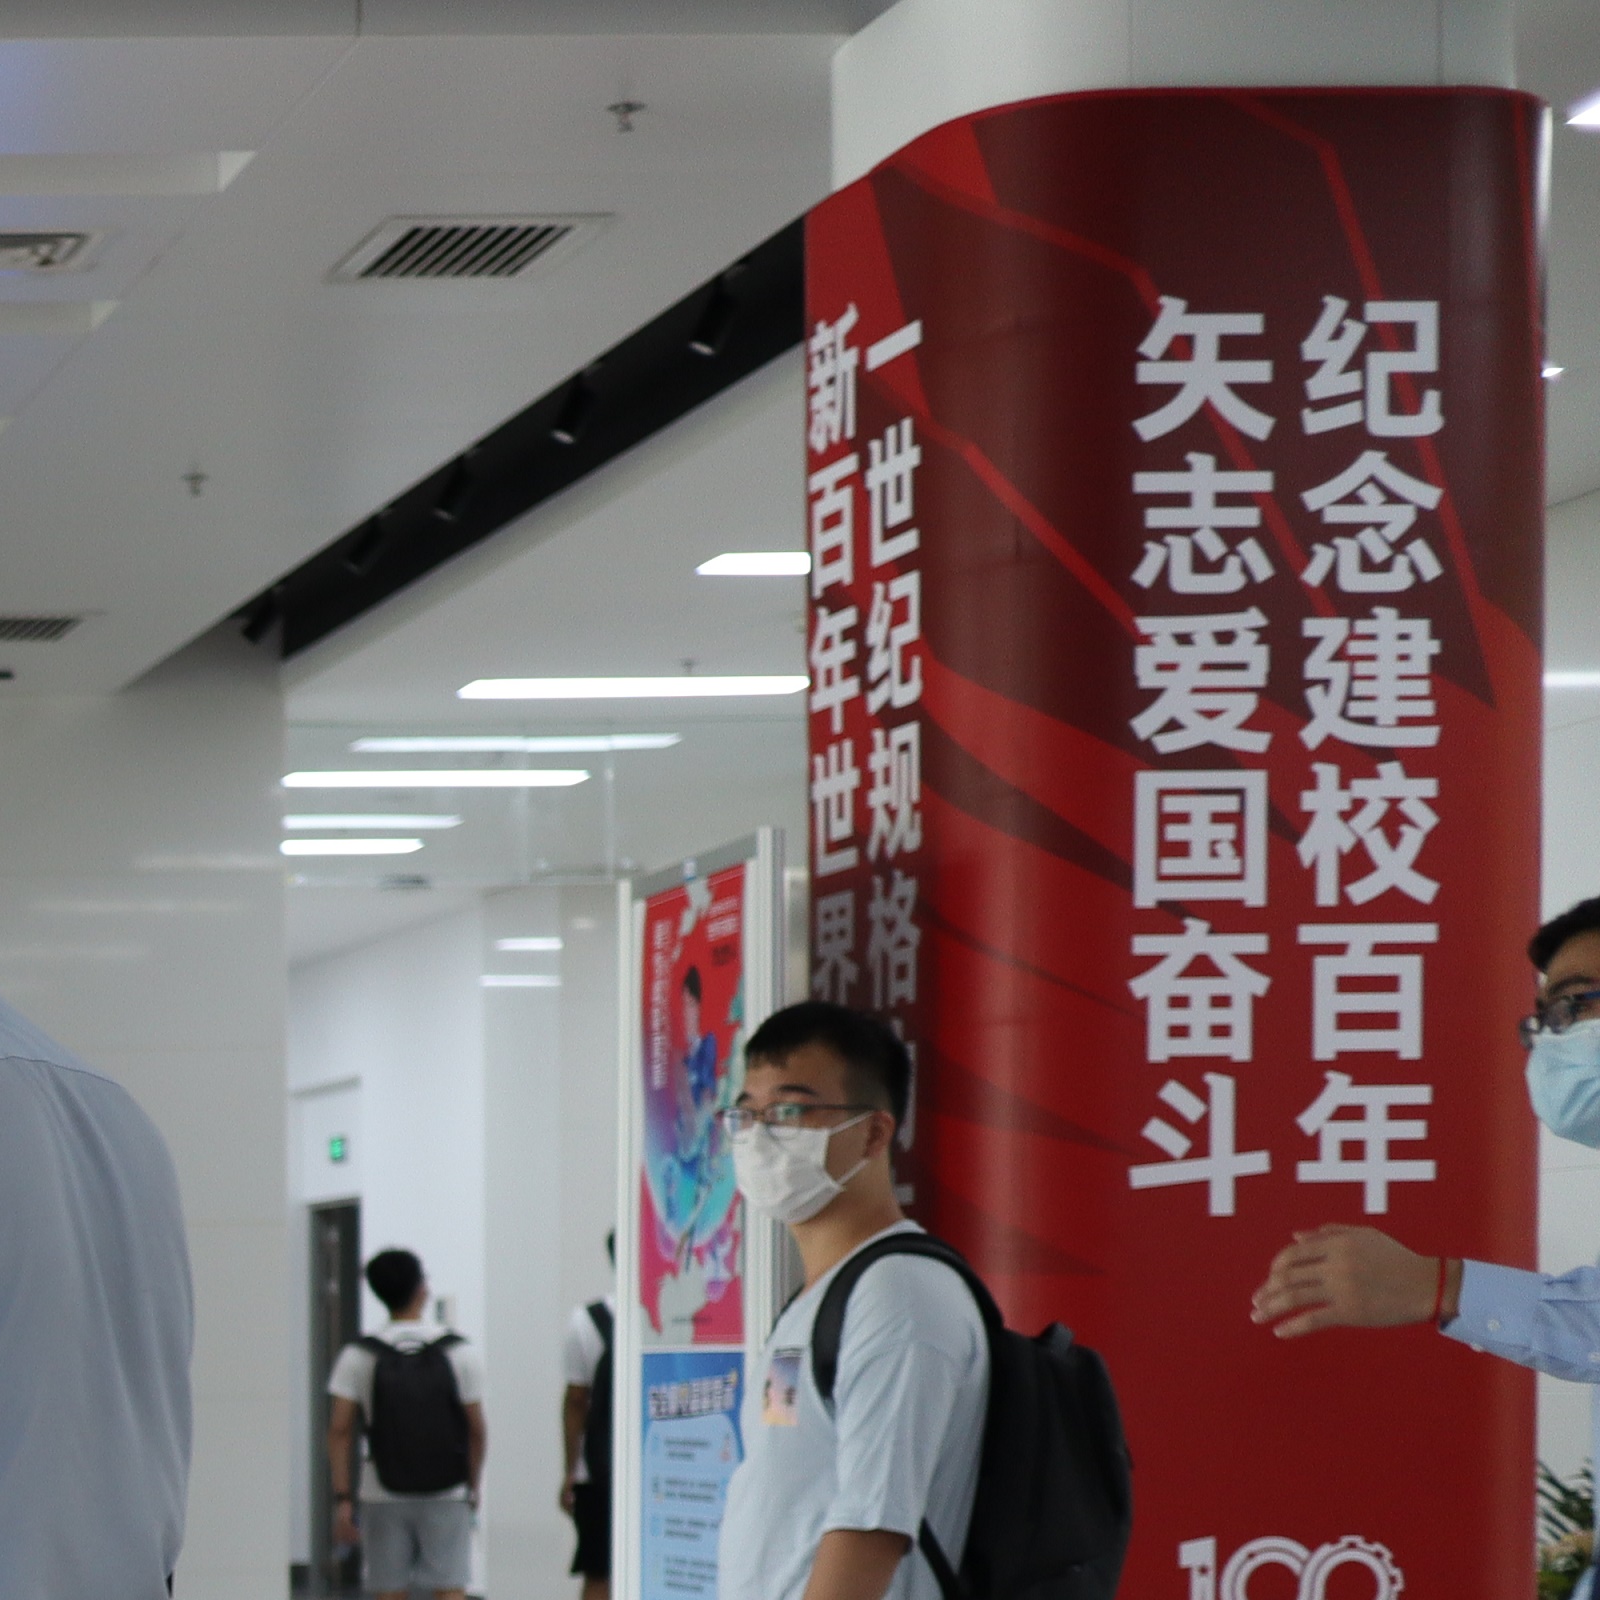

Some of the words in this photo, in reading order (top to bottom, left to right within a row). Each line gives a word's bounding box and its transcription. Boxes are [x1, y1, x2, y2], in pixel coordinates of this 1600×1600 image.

[808, 302, 860, 1005] 新百年世界
[864, 318, 924, 1206] 一世纪规格
[1129, 294, 1275, 1217] 矢志爱国奋斗
[1296, 294, 1445, 1215] 纪念建校百年
